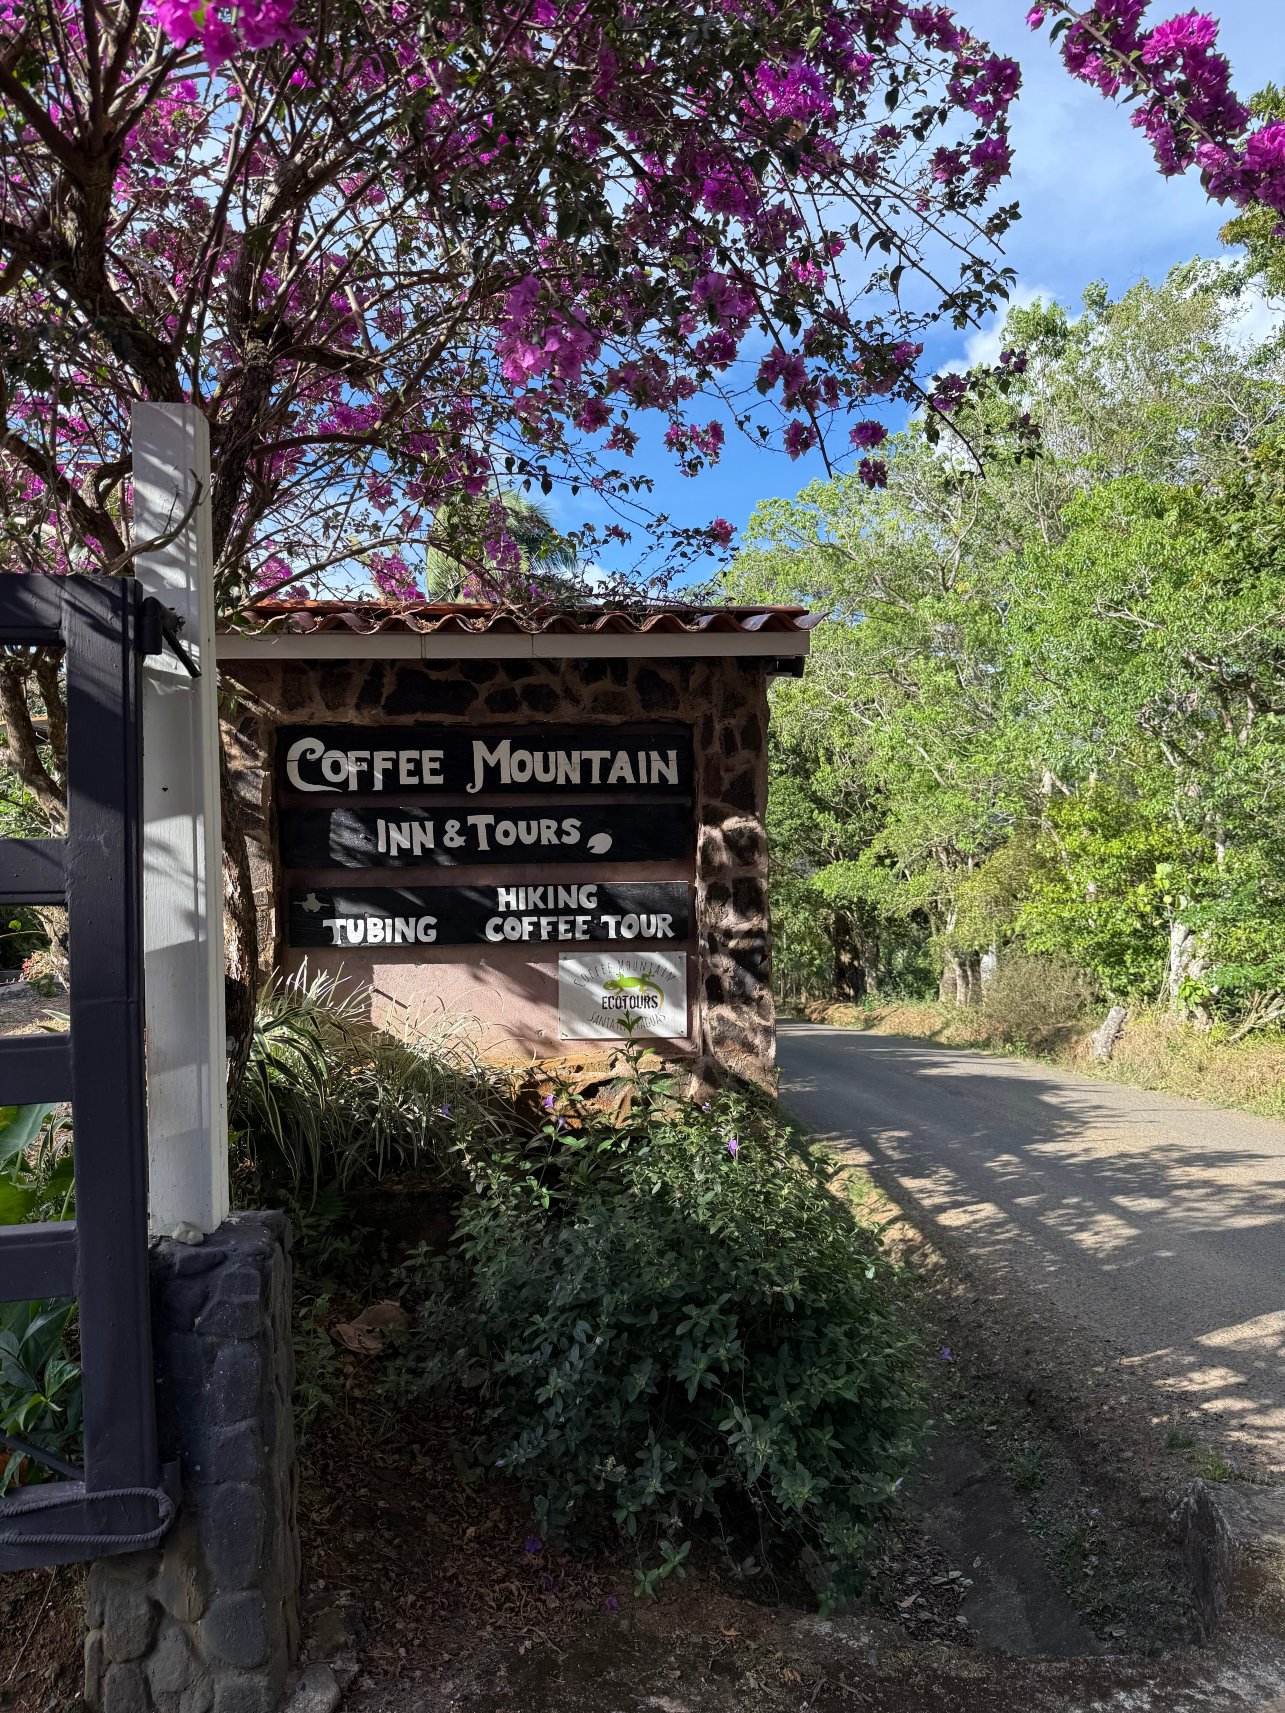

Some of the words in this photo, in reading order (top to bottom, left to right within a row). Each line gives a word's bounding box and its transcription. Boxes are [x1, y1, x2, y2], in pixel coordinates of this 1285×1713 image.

[286, 737, 444, 793] COFFEE
[465, 739, 679, 794] MOUNTAIN
[377, 818, 435, 856] INN
[467, 815, 582, 851] TOURS
[496, 885, 598, 911] HIKING
[323, 915, 437, 945] TUBING
[485, 914, 591, 942] COFFEE
[600, 913, 675, 939] TOUR
[573, 962, 613, 987] COFFEE
[617, 959, 676, 982] MOUNTAIN
[601, 995, 659, 1010] ECOTOURS
